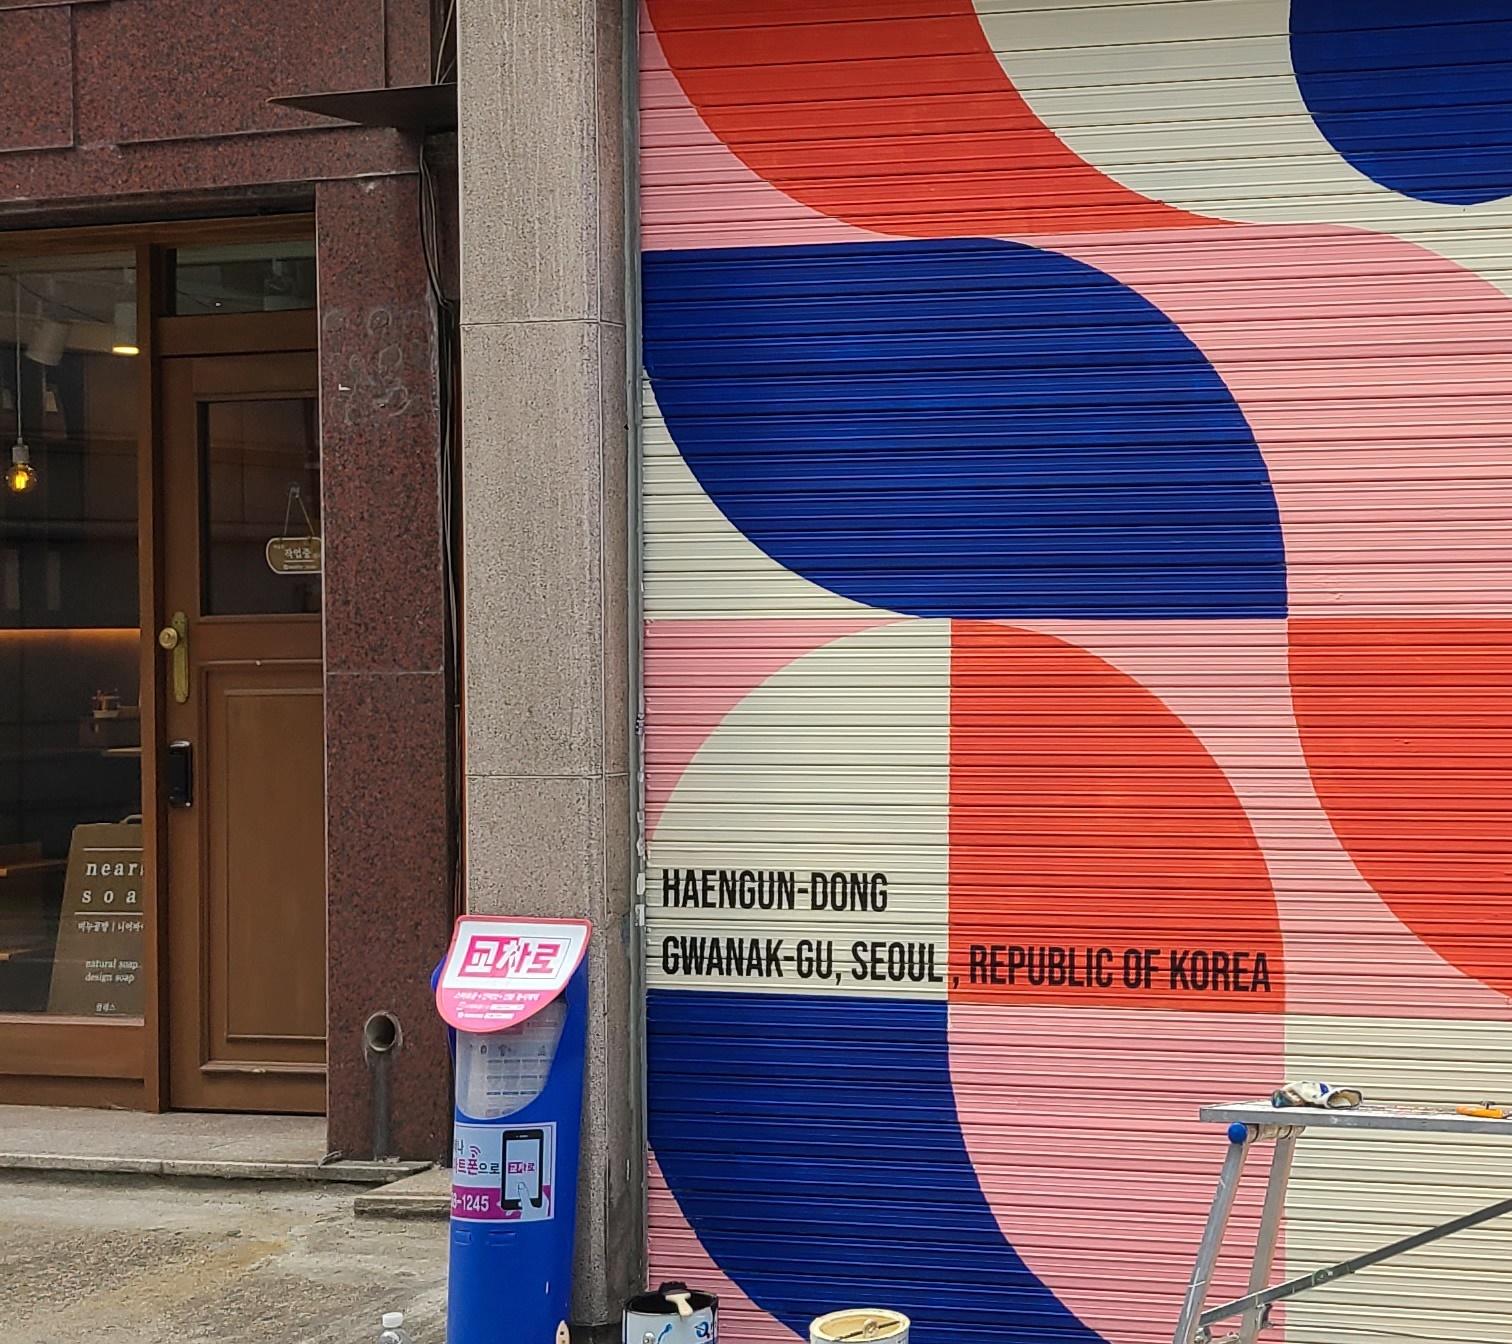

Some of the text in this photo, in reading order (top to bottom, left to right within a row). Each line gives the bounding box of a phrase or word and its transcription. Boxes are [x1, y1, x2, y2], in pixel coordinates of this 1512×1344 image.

[662, 868, 888, 912] HAENGUN-DONG
[464, 940, 561, 975] 교차로
[662, 936, 842, 985] GWANAK-GU,
[970, 944, 1113, 988] REPUBLIC
[1122, 947, 1161, 989] OF
[1169, 949, 1271, 993] KOREA
